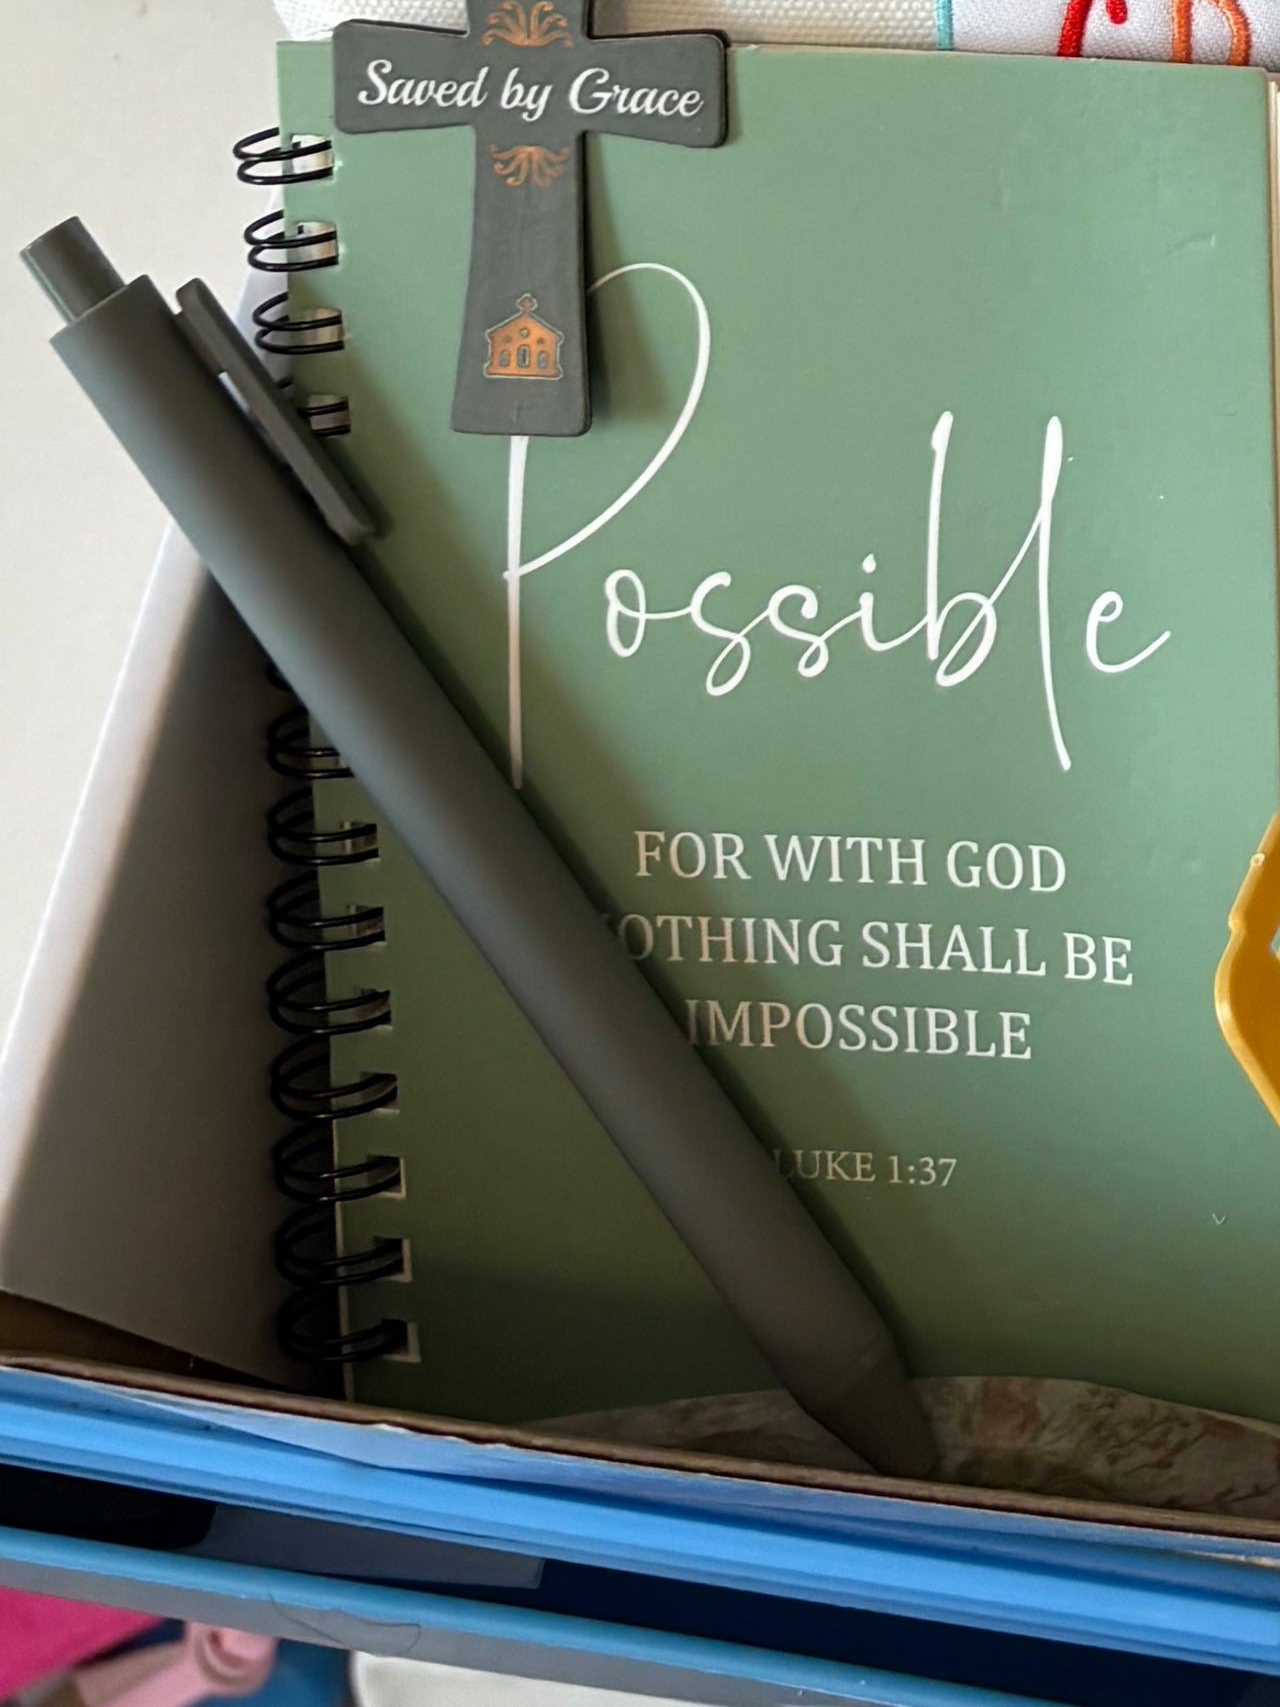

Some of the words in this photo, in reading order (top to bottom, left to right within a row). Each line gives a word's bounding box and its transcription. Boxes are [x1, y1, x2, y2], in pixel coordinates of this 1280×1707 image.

[356, 57, 489, 113] Saved
[500, 66, 552, 124] by
[566, 64, 705, 120] Grace
[502, 262, 1172, 792] Possible
[634, 829, 751, 880] FOR
[764, 833, 927, 887] WITH
[946, 840, 1068, 894] GOD
[600, 912, 844, 968] OTHING
[860, 920, 1048, 978] SHALL
[1063, 932, 1134, 987] BE
[685, 998, 1034, 1062] IMPOSSIBLE
[773, 1148, 877, 1183] LUKE
[887, 1155, 958, 1187] 1:37
